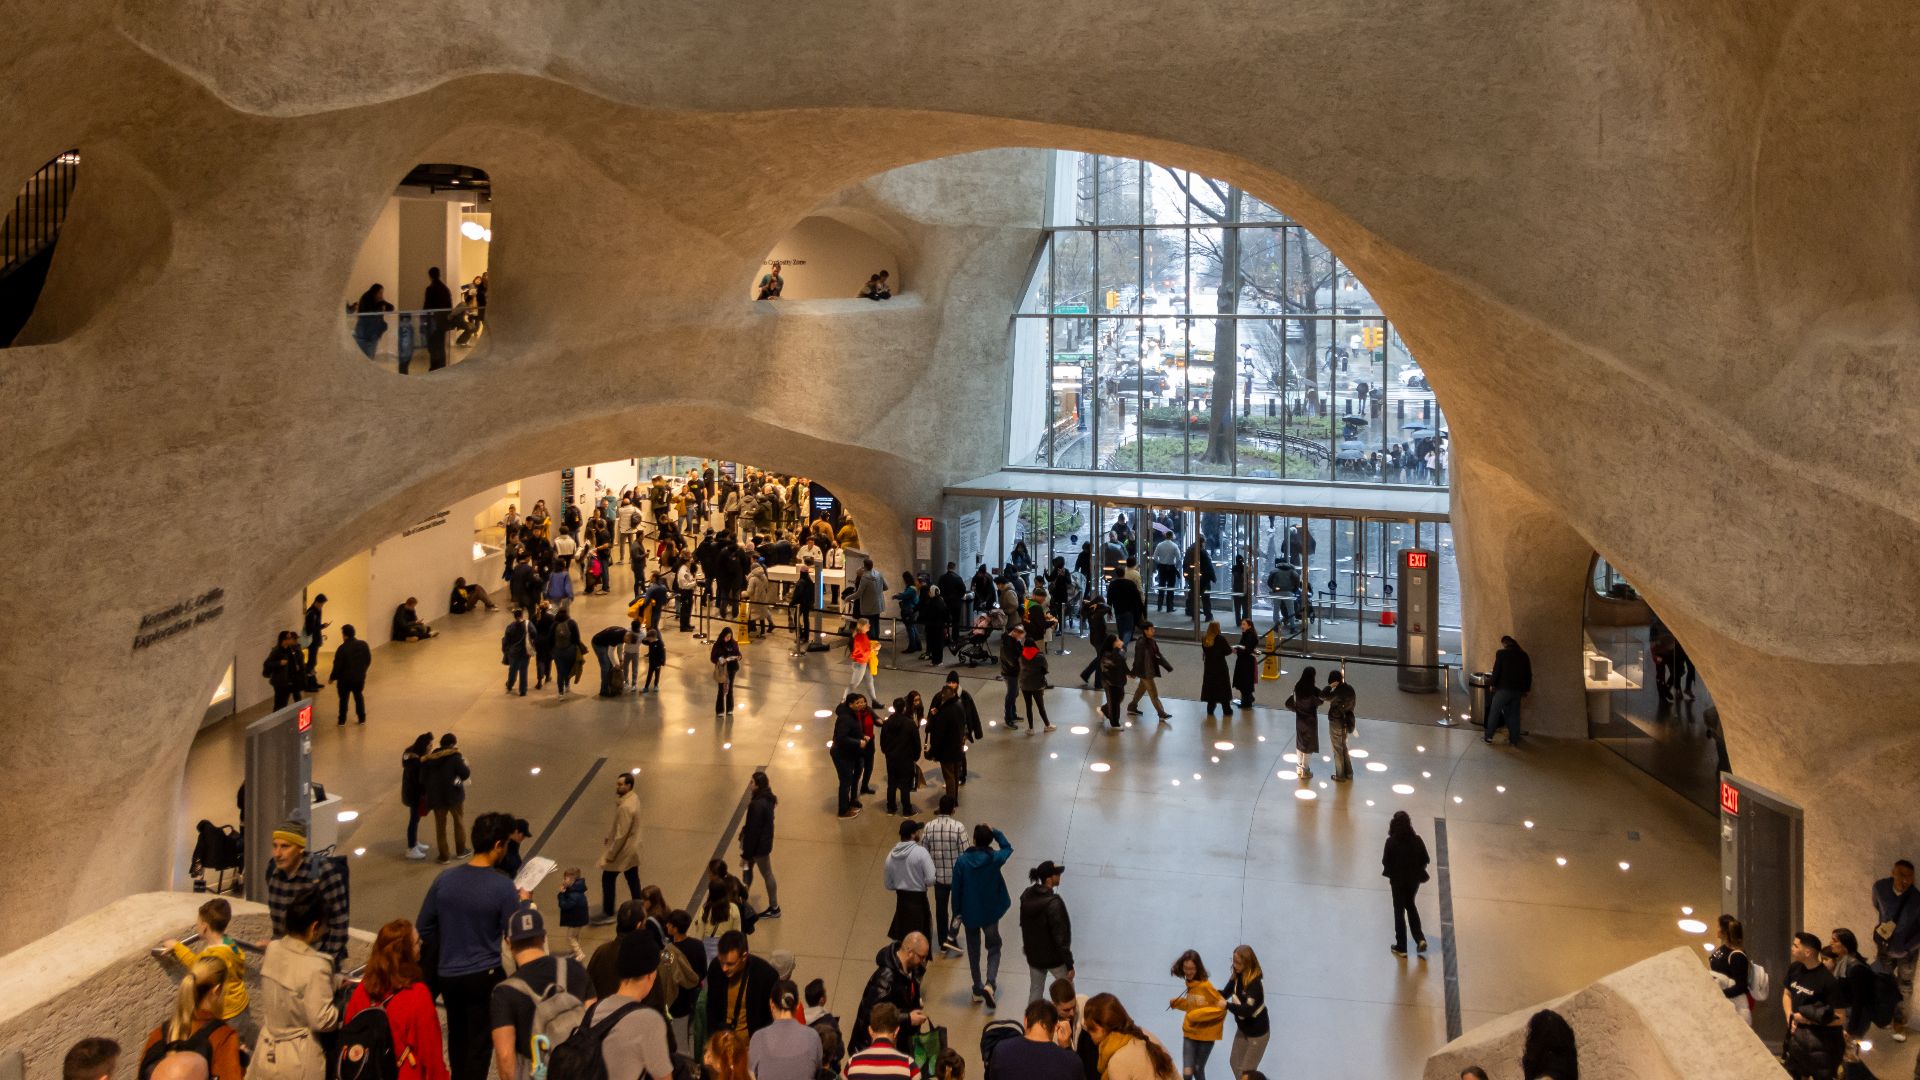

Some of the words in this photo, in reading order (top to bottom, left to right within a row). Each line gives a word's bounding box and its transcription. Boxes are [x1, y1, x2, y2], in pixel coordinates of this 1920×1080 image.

[917, 519, 931, 531] EXIT
[1409, 553, 1427, 567] EXIT
[1723, 783, 1739, 813] EXIT
